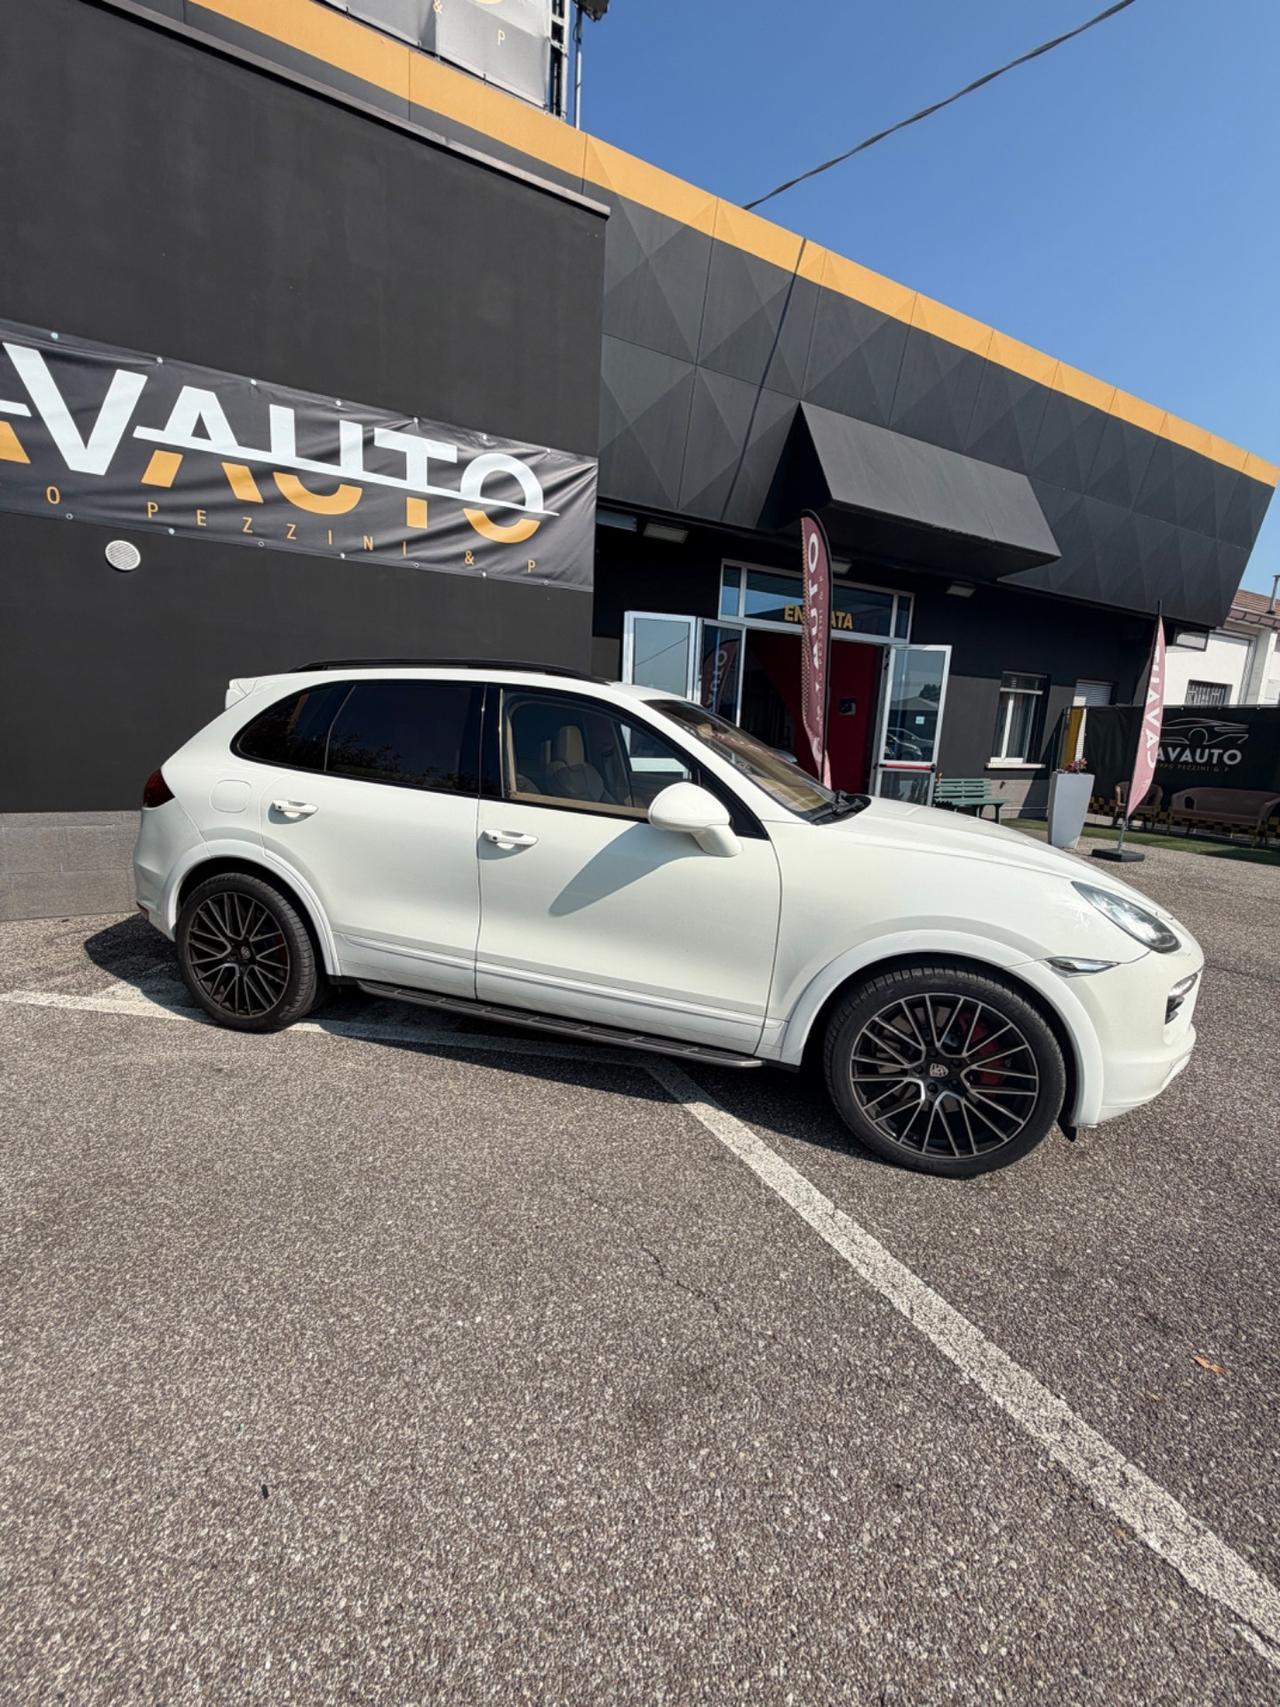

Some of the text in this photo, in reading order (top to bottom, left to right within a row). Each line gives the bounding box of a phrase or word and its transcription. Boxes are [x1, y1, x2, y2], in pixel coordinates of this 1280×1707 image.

[497, 29, 506, 46] P
[147, 501, 408, 558] PEZZINI
[464, 550, 475, 566] &
[528, 559, 537, 574] P
[1157, 746, 1242, 765] AVAUTO
